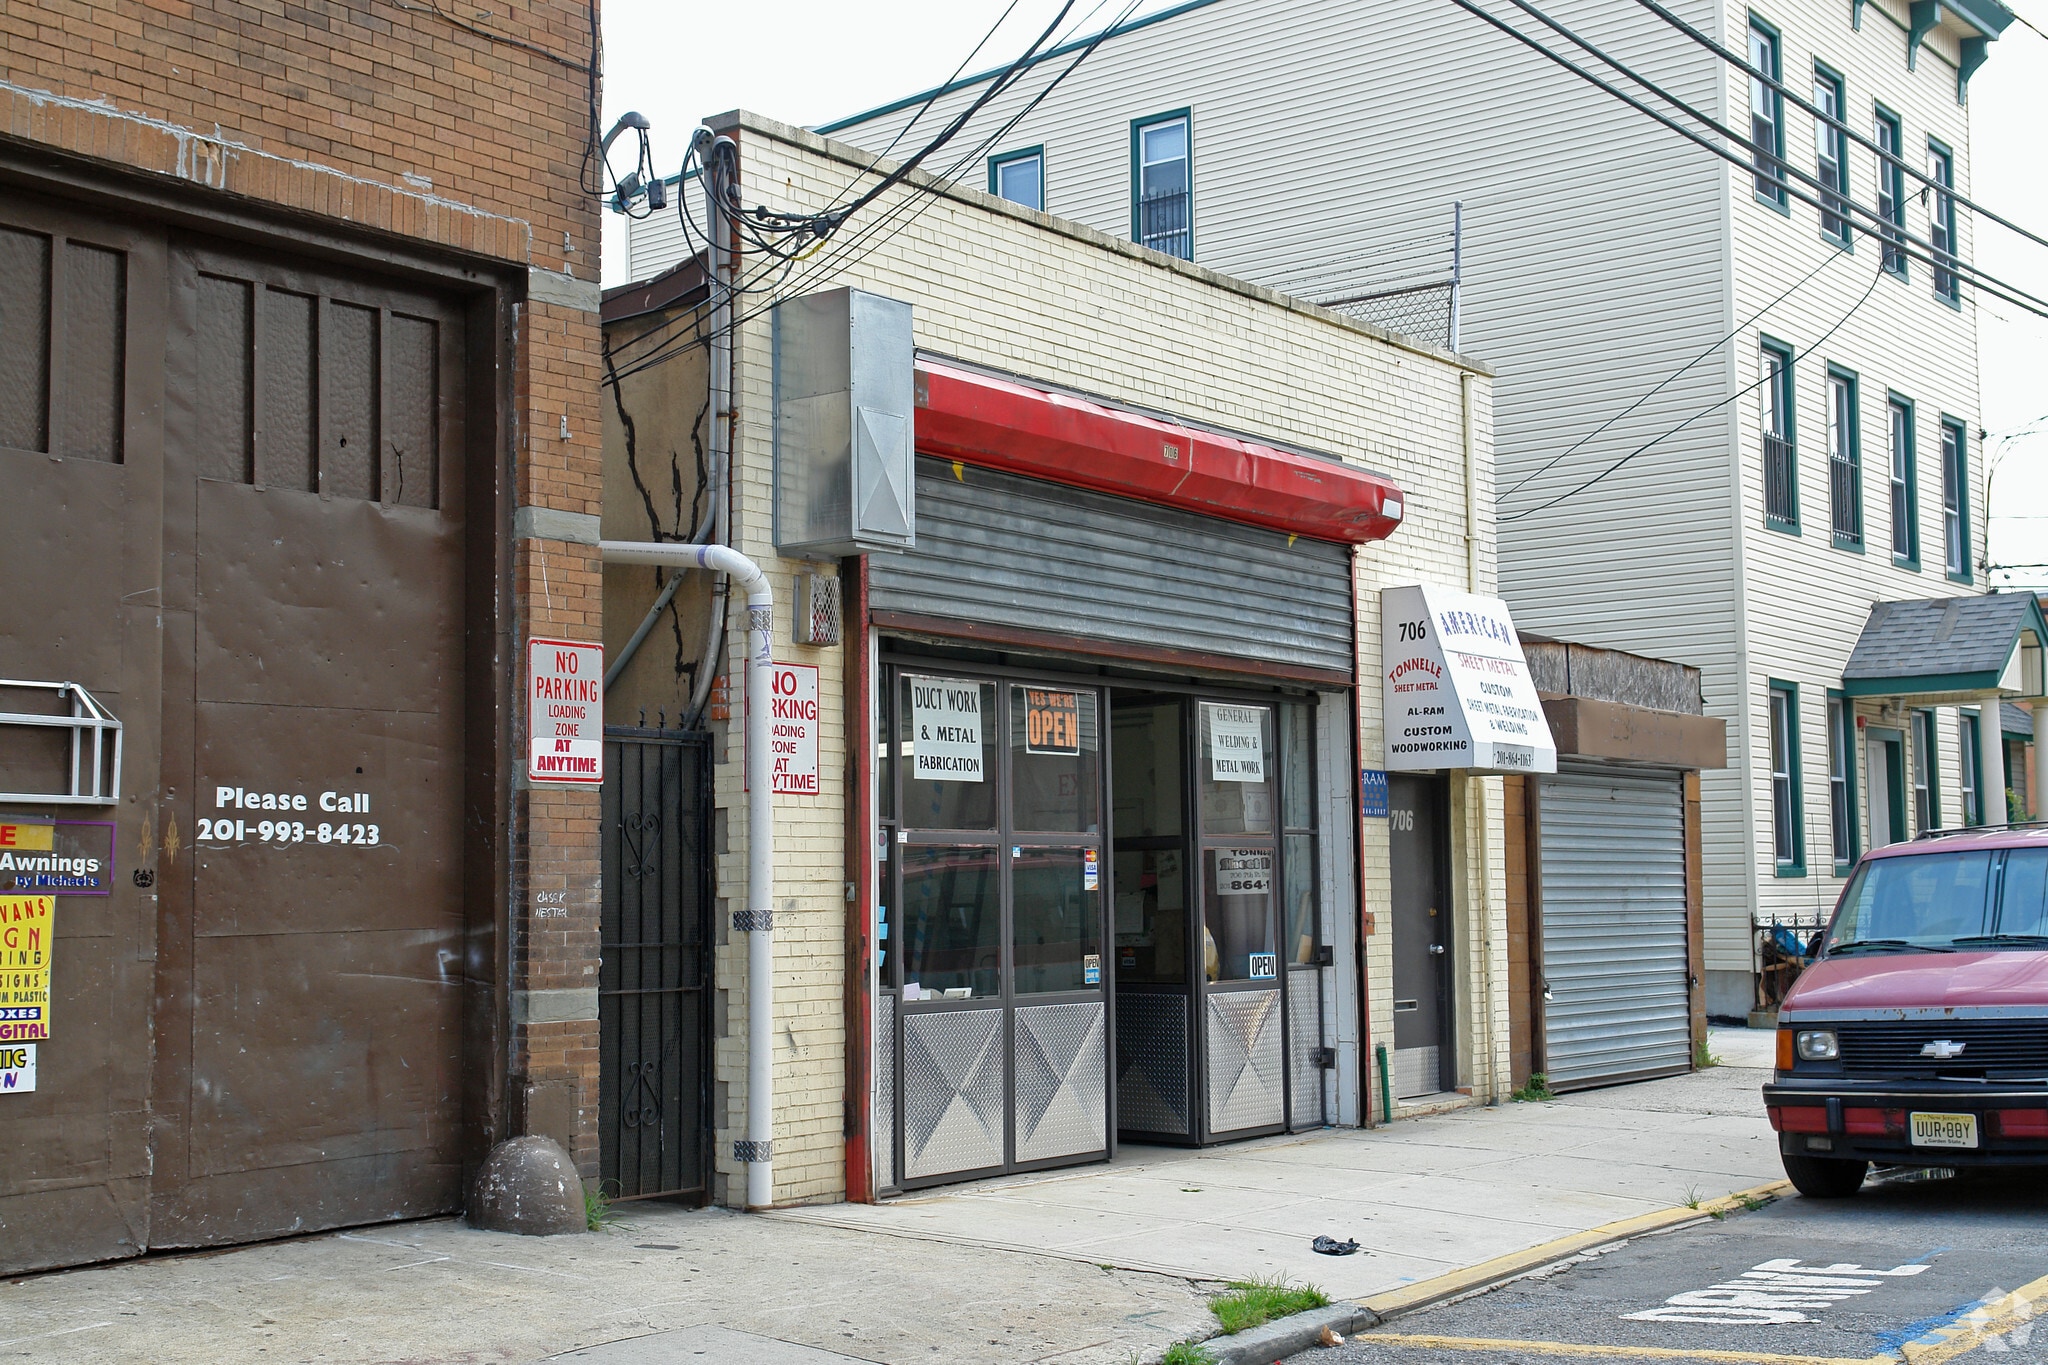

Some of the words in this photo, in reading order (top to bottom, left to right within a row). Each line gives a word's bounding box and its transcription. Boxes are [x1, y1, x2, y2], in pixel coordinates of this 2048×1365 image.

[1399, 621, 1426, 642] 706
[1440, 611, 1511, 646] AMERICAN
[555, 651, 578, 674] NO
[1389, 658, 1442, 684] TONNELLE
[1458, 653, 1485, 670] SHEET
[1487, 659, 1518, 677] METAL
[536, 676, 597, 702] PARKING
[1394, 684, 1414, 693] SHEET
[1416, 682, 1439, 692] METAL
[1480, 681, 1513, 698] CUSTOM
[915, 686, 942, 710] DUCT
[947, 689, 978, 713] WORK
[1029, 691, 1046, 706] YES
[1048, 693, 1075, 708] WE'RE
[548, 704, 586, 719] LOADING
[1217, 708, 1253, 723] GENERAL
[1407, 707, 1445, 716] AL-RAM
[555, 723, 579, 736] ZONE
[921, 725, 931, 740] &
[937, 726, 977, 743] METAL
[1029, 709, 1077, 747] OPEN
[1404, 726, 1452, 737] CUSTOM
[1496, 721, 1528, 736] WELDING
[555, 739, 572, 752] AT
[1218, 734, 1249, 748] WELDING
[1252, 736, 1258, 749] &
[1391, 740, 1468, 753] WOODWORKING
[537, 756, 597, 773] ANYTIME
[774, 758, 789, 773] AT
[919, 755, 980, 772] FABRICATION
[1216, 760, 1239, 773] METAL
[1240, 760, 1261, 775] WORK
[215, 786, 308, 811] Please
[319, 791, 370, 813] Call
[1391, 809, 1414, 831] 706
[0, 825, 17, 846] E
[196, 818, 380, 845] 201-993-8423
[0, 852, 99, 876] Awnings
[15, 874, 32, 888] by
[36, 874, 100, 887] Michael's
[1085, 959, 1099, 968] OPEN
[1251, 956, 1275, 975] OPEN
[14, 991, 47, 1003] PLASTIC
